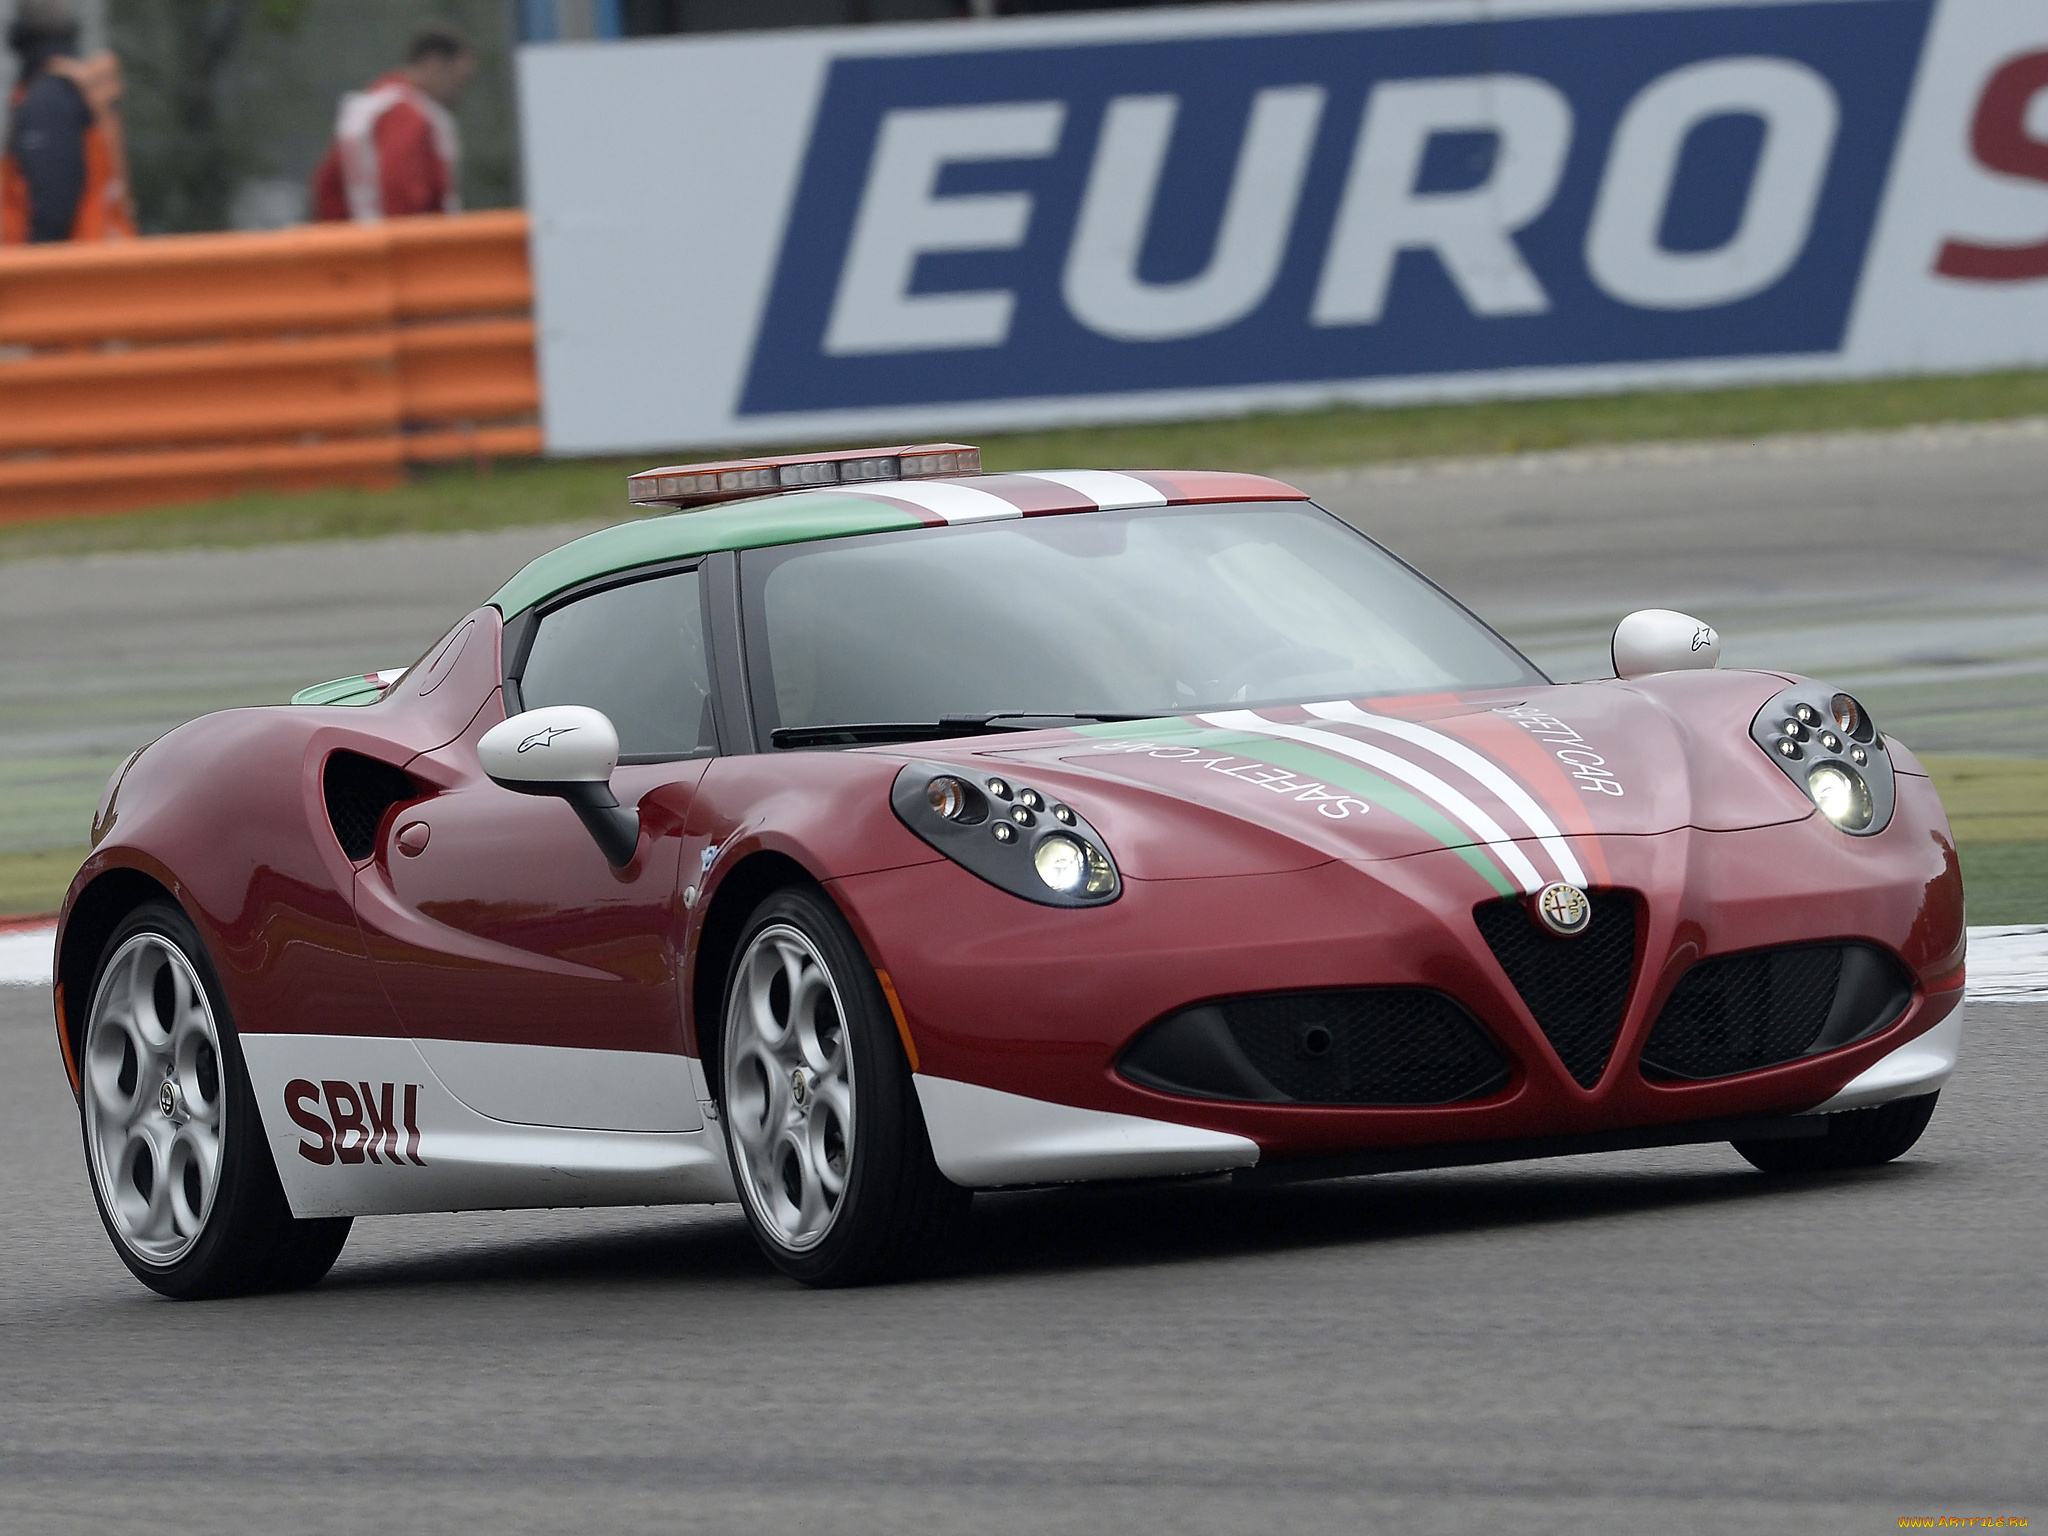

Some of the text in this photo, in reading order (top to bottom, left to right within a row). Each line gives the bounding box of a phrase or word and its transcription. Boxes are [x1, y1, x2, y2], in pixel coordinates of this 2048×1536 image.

[820, 56, 1842, 356] EURO
[1092, 741, 1370, 819] SAFETY CAR
[1492, 707, 1624, 796] SAFETY CAR
